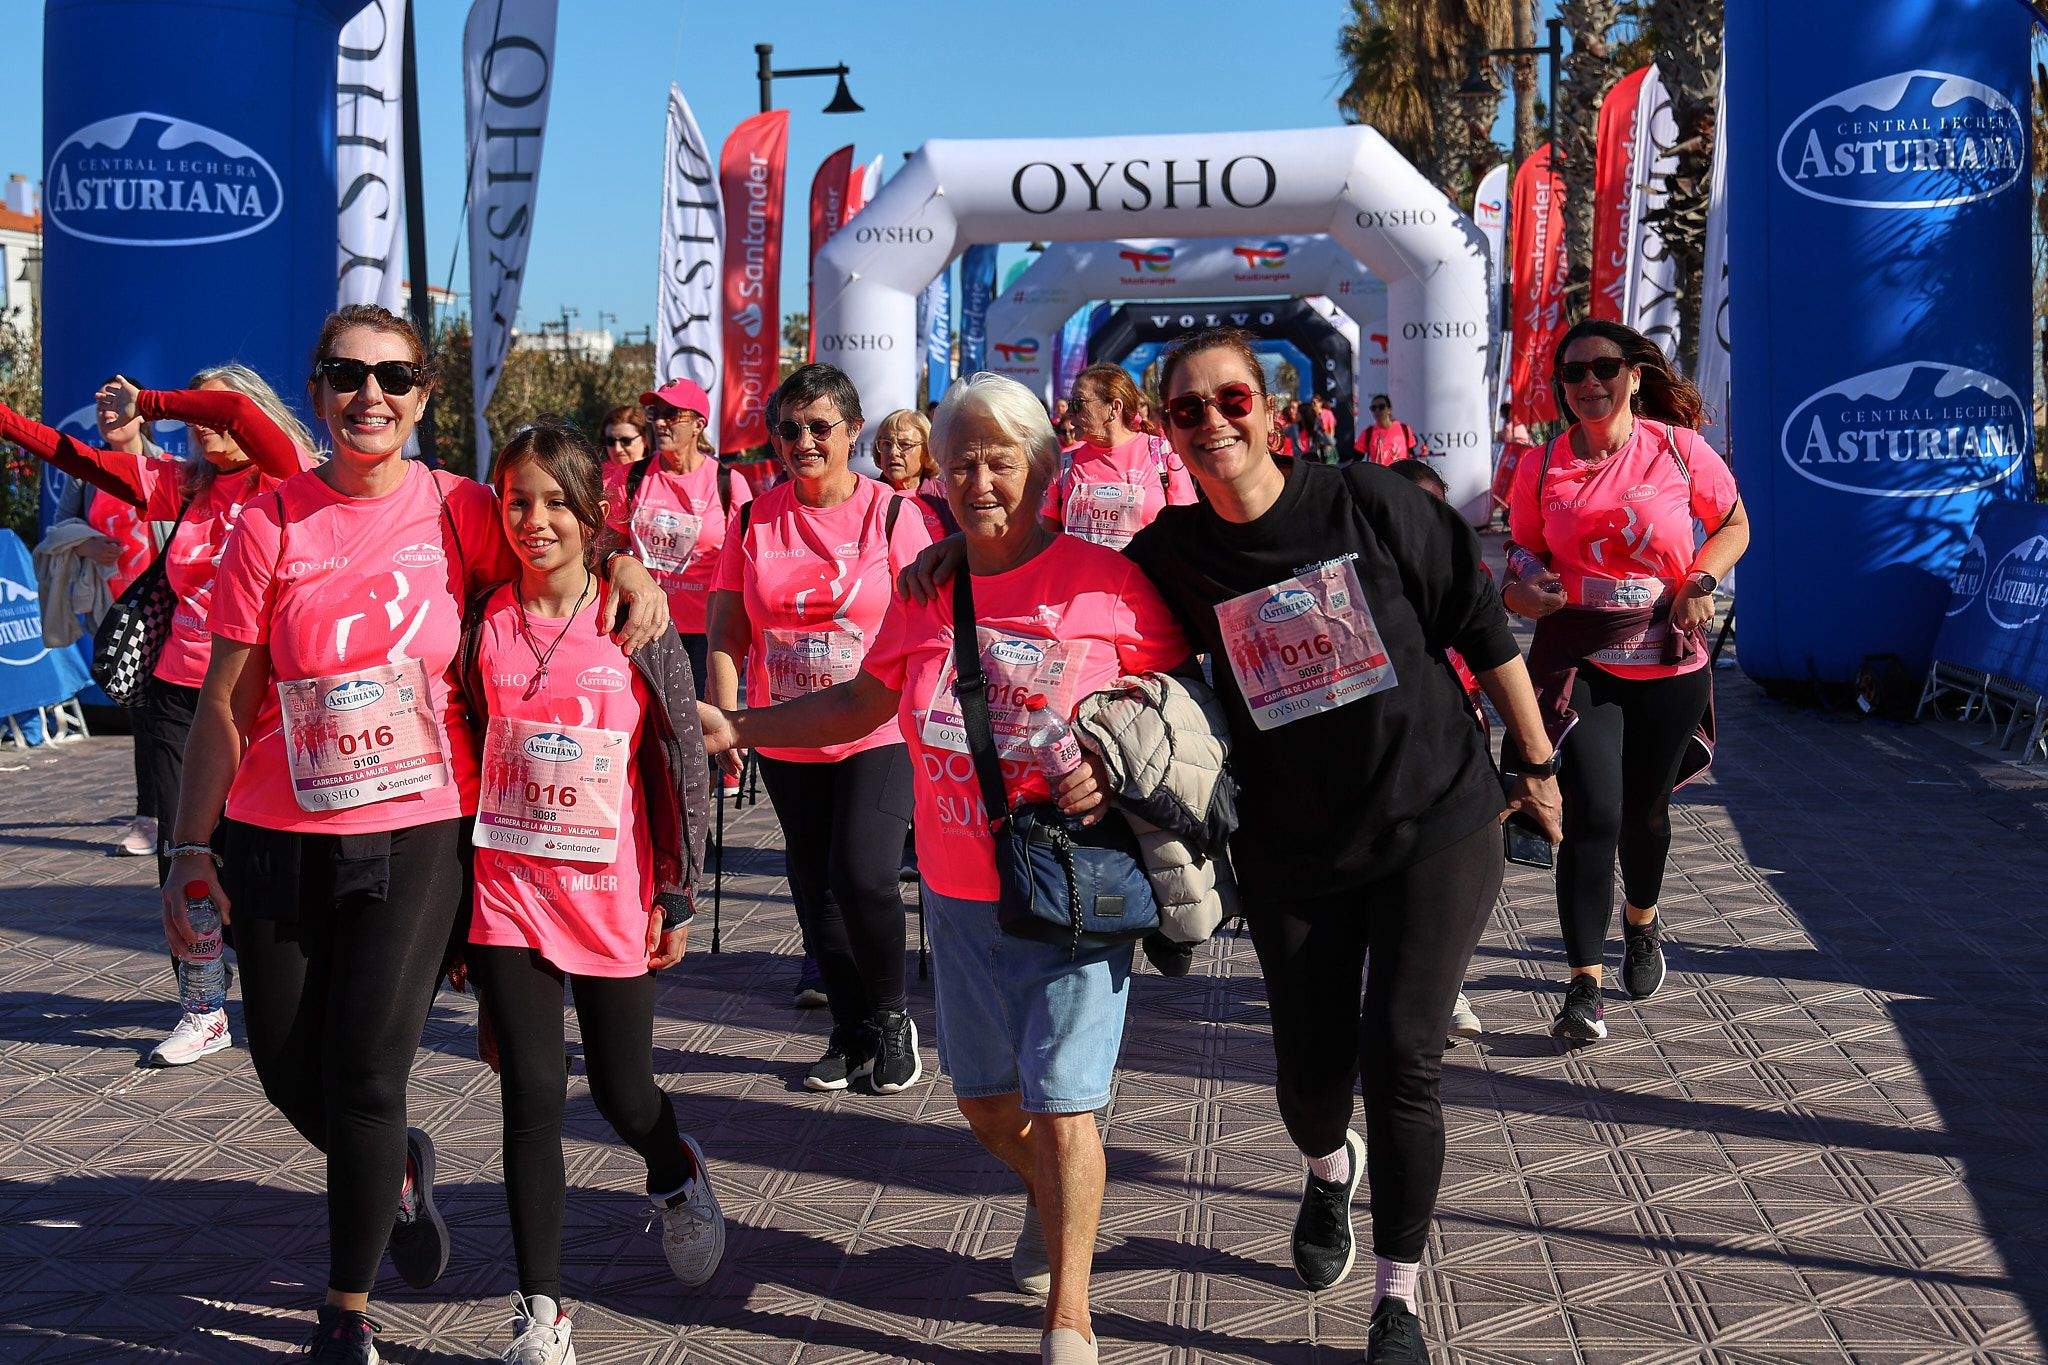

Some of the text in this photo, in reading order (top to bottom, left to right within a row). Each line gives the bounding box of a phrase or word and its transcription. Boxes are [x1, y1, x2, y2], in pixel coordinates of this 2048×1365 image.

[1837, 118, 1930, 136] CENTRAL
[1795, 128, 2018, 180] ASTURIANA
[78, 158, 257, 178] CENTRAL LECHERA
[53, 163, 266, 218] ASTURIANA
[1011, 155, 1277, 214] OYSHO
[1356, 209, 1436, 229] OYSHO
[856, 226, 933, 244] OYSHO
[1530, 180, 1550, 300] Santander
[667, 134, 719, 393] OYSHO
[735, 153, 769, 430] Sports Santander
[1151, 311, 1275, 328] VOLVO
[1402, 321, 1477, 341] OYSHO
[822, 334, 894, 352] OYSHO
[1841, 405, 2014, 423] CENTRAL LECHERA
[1412, 431, 1478, 449] YSHO
[1799, 414, 2019, 464] ASTURIANA
[1091, 509, 1119, 521] 016
[1550, 499, 1587, 512] OYSHO
[651, 535, 677, 549] 016
[1263, 598, 1314, 620] ASTURIANA
[992, 645, 1040, 661] ASTURIANA
[1281, 633, 1333, 667] 016
[491, 673, 527, 687] SHO
[795, 672, 833, 688] 016
[1298, 664, 1324, 679] 9096
[1264, 688, 1292, 703] CARRERA
[1293, 684, 1303, 694] DE
[1303, 681, 1312, 690] LA
[1312, 676, 1333, 688] MUJER
[1338, 661, 1370, 680] VALENCIA
[328, 689, 380, 707] ASTURIANA
[985, 683, 1029, 708] 016
[1268, 675, 1380, 720] OYSHO Santander
[946, 715, 965, 726] CARR
[338, 725, 394, 756] 016
[940, 729, 967, 744] OYS
[527, 741, 578, 757] ASTURIANA
[353, 754, 380, 769] 9100
[312, 757, 427, 787] CARRERA DE LA MUJER VALENCIA
[313, 773, 432, 804] OYSHO Santander
[524, 781, 577, 807] 016
[532, 809, 557, 822] 9098
[494, 816, 520, 828] CARRERA
[521, 820, 530, 828] DE
[540, 823, 562, 833] MUJER
[568, 827, 600, 837] VALENCIA
[489, 830, 601, 854] OYSHO Santander
[571, 875, 618, 891] MUJER
